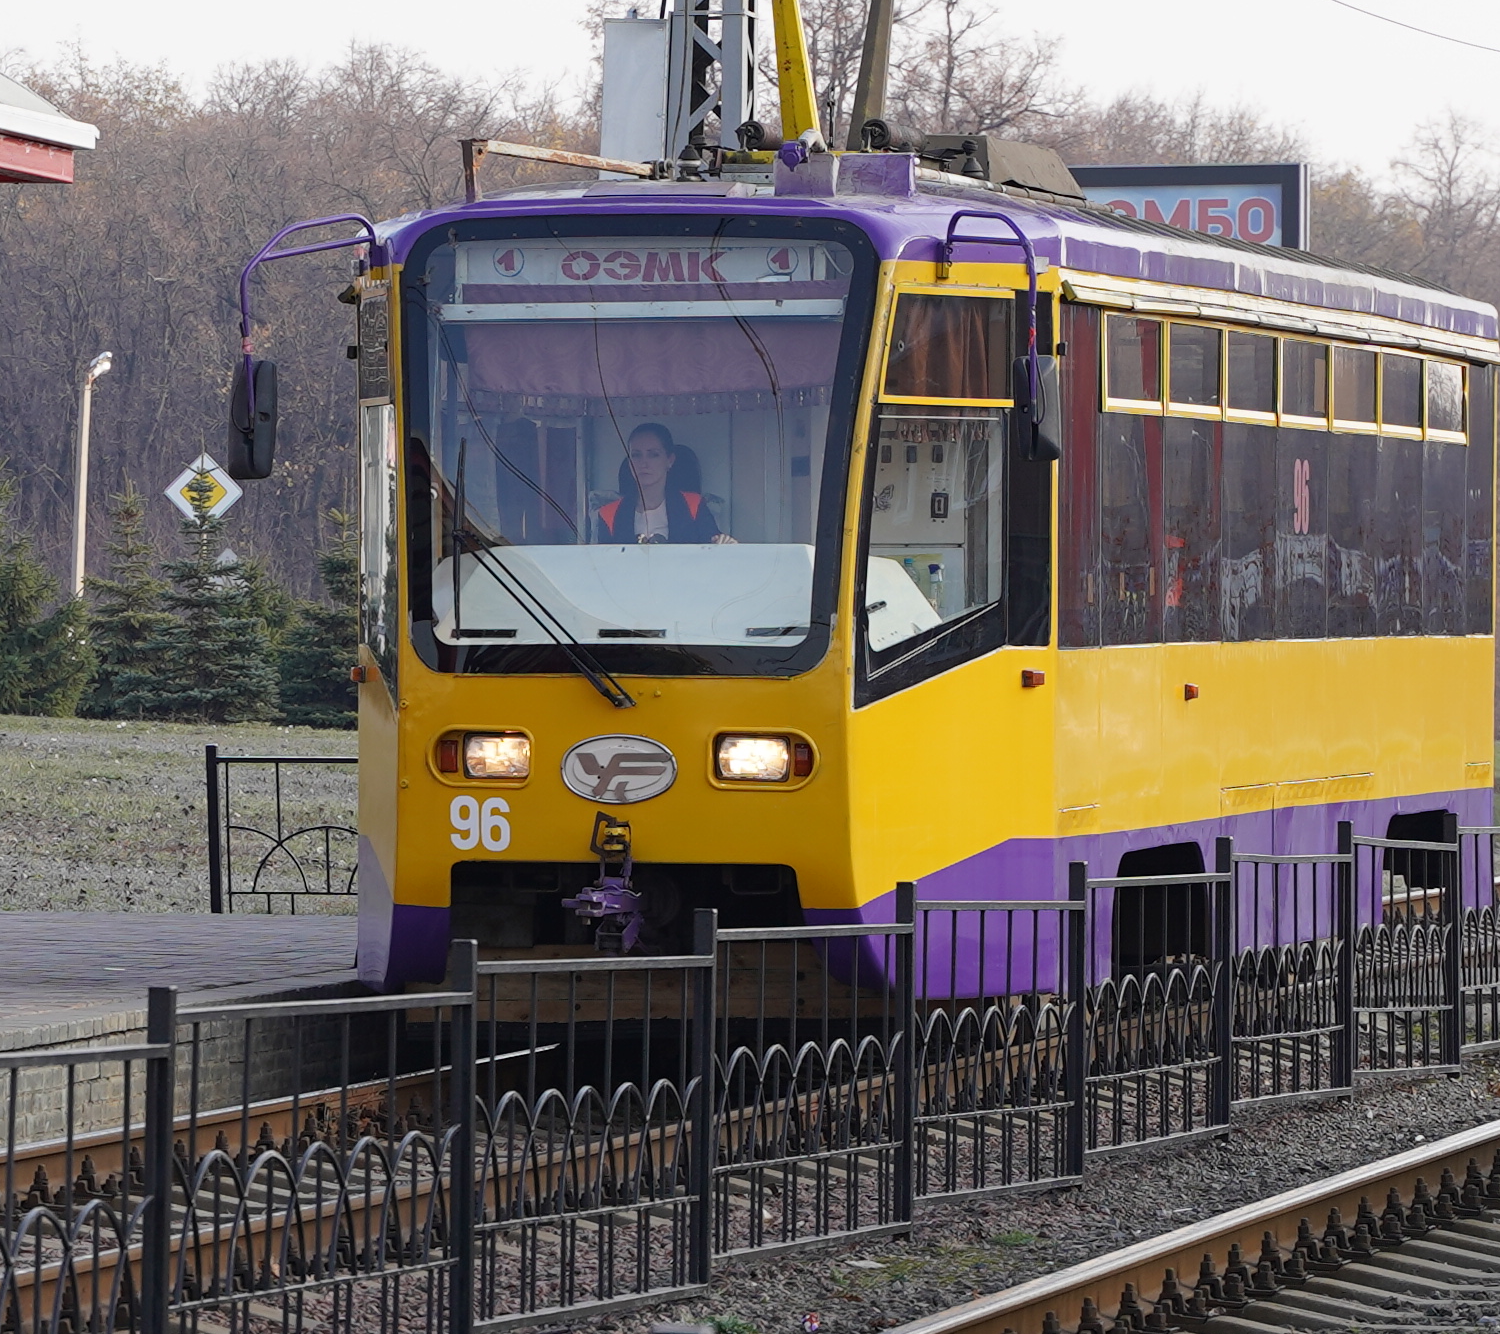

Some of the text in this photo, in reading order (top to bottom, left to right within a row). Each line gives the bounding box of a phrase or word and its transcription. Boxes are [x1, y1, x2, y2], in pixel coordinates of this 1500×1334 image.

[496, 249, 515, 272] 1
[561, 250, 729, 282] ОЭМК
[769, 247, 790, 270] 1
[1293, 458, 1310, 535] 96
[450, 795, 511, 852] 96
